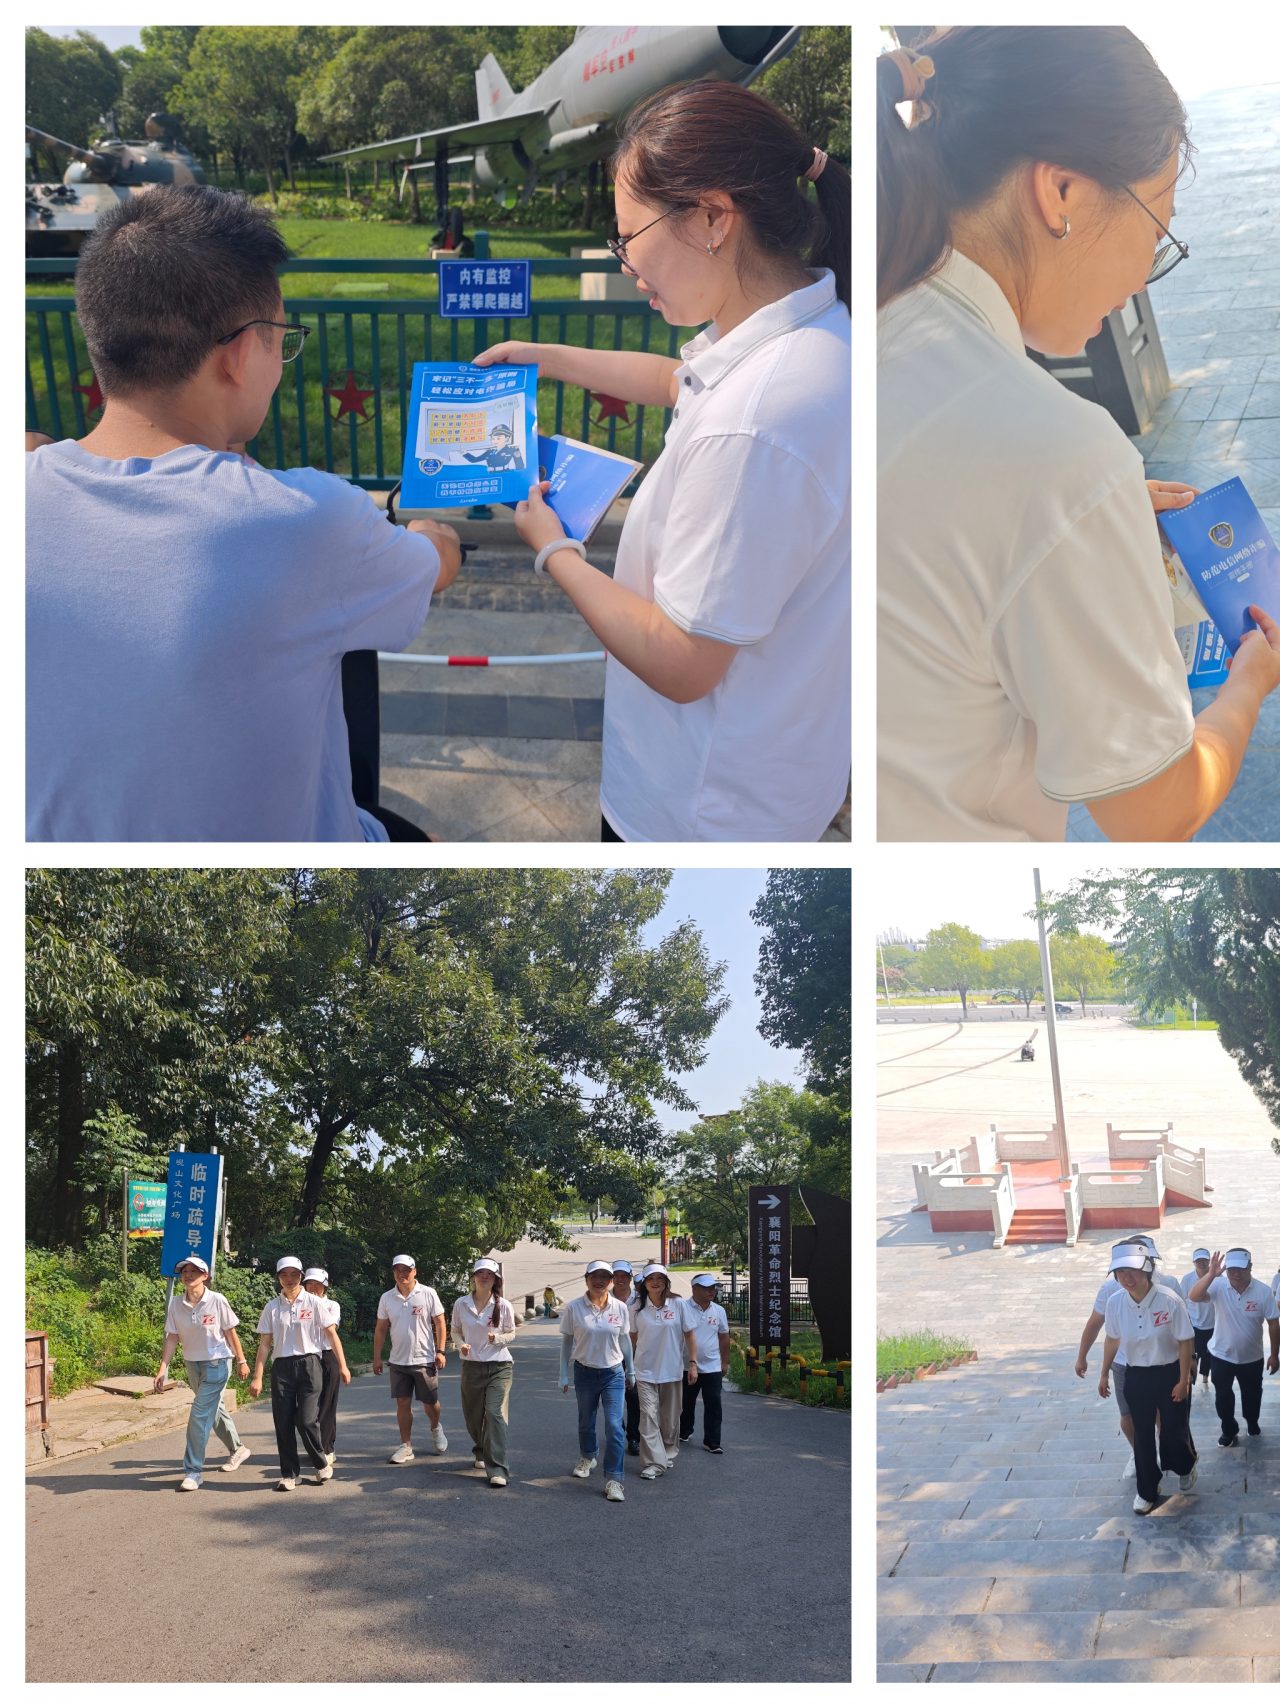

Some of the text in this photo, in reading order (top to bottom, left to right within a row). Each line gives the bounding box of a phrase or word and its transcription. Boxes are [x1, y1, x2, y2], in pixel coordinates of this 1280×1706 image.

[459, 268, 512, 286] 内有监控
[446, 292, 524, 310] 严禁攀爬翻越
[170, 1157, 184, 1220] 岘山文化广场
[768, 1216, 782, 1339] 襄阳革命烈士纪念馆
